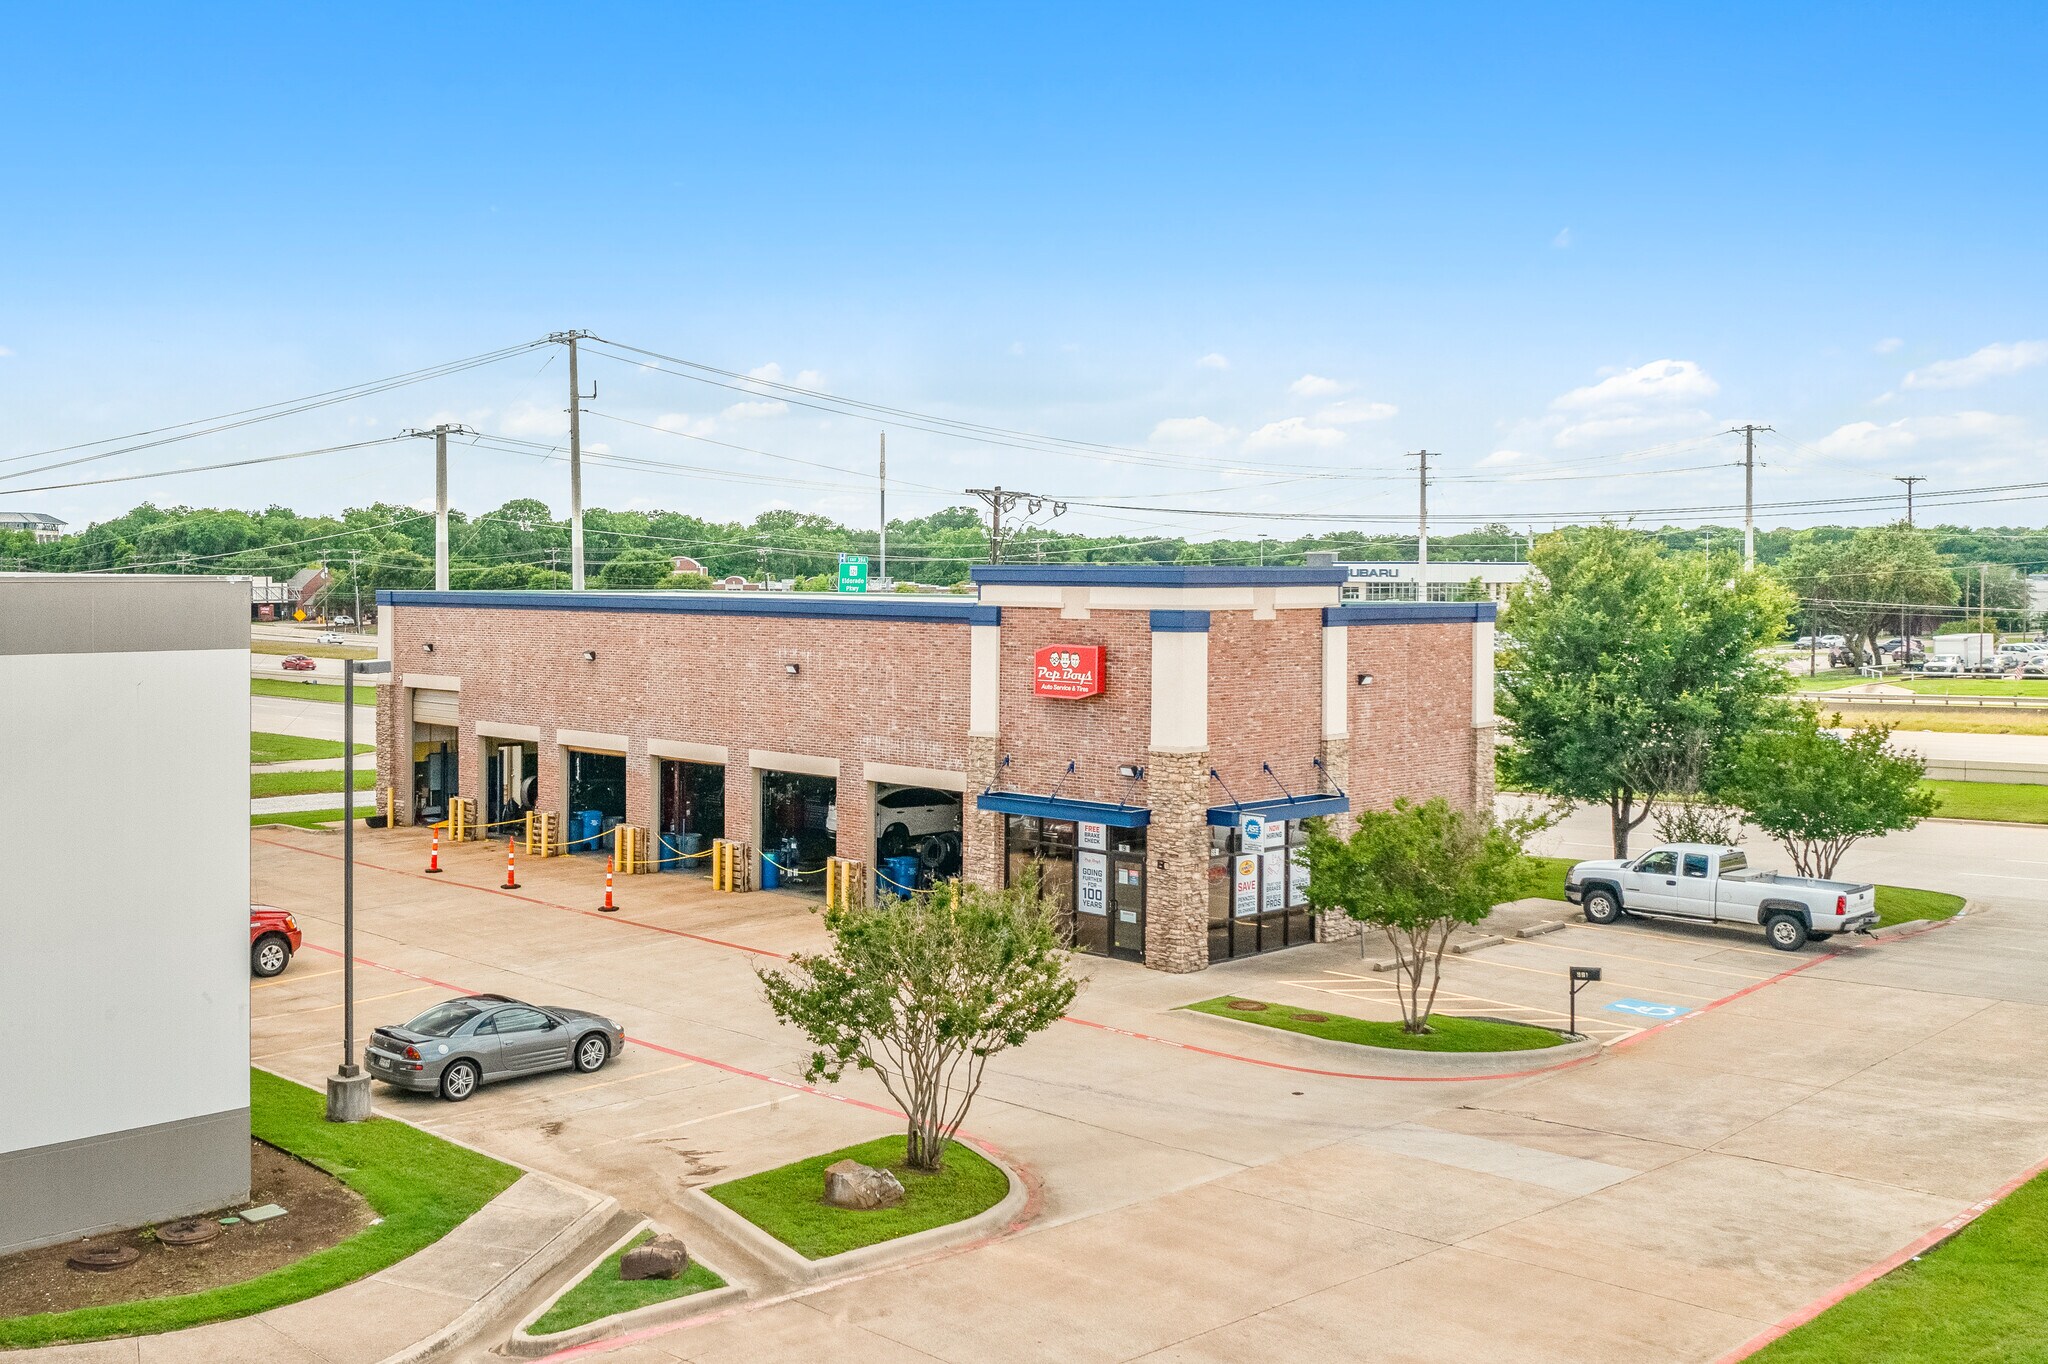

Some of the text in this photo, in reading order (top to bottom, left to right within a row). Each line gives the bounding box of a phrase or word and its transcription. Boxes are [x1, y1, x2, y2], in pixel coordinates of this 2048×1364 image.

[1348, 569, 1399, 577] UBARU
[1037, 666, 1093, 685] Pep Boys
[1084, 825, 1100, 833] FREE
[1266, 831, 1282, 839] HIRING
[1082, 868, 1103, 877] GOING
[1238, 880, 1256, 892] SAVE
[1082, 887, 1102, 901] 100
[1082, 899, 1103, 909] YEARS
[1266, 898, 1282, 908] PROS
